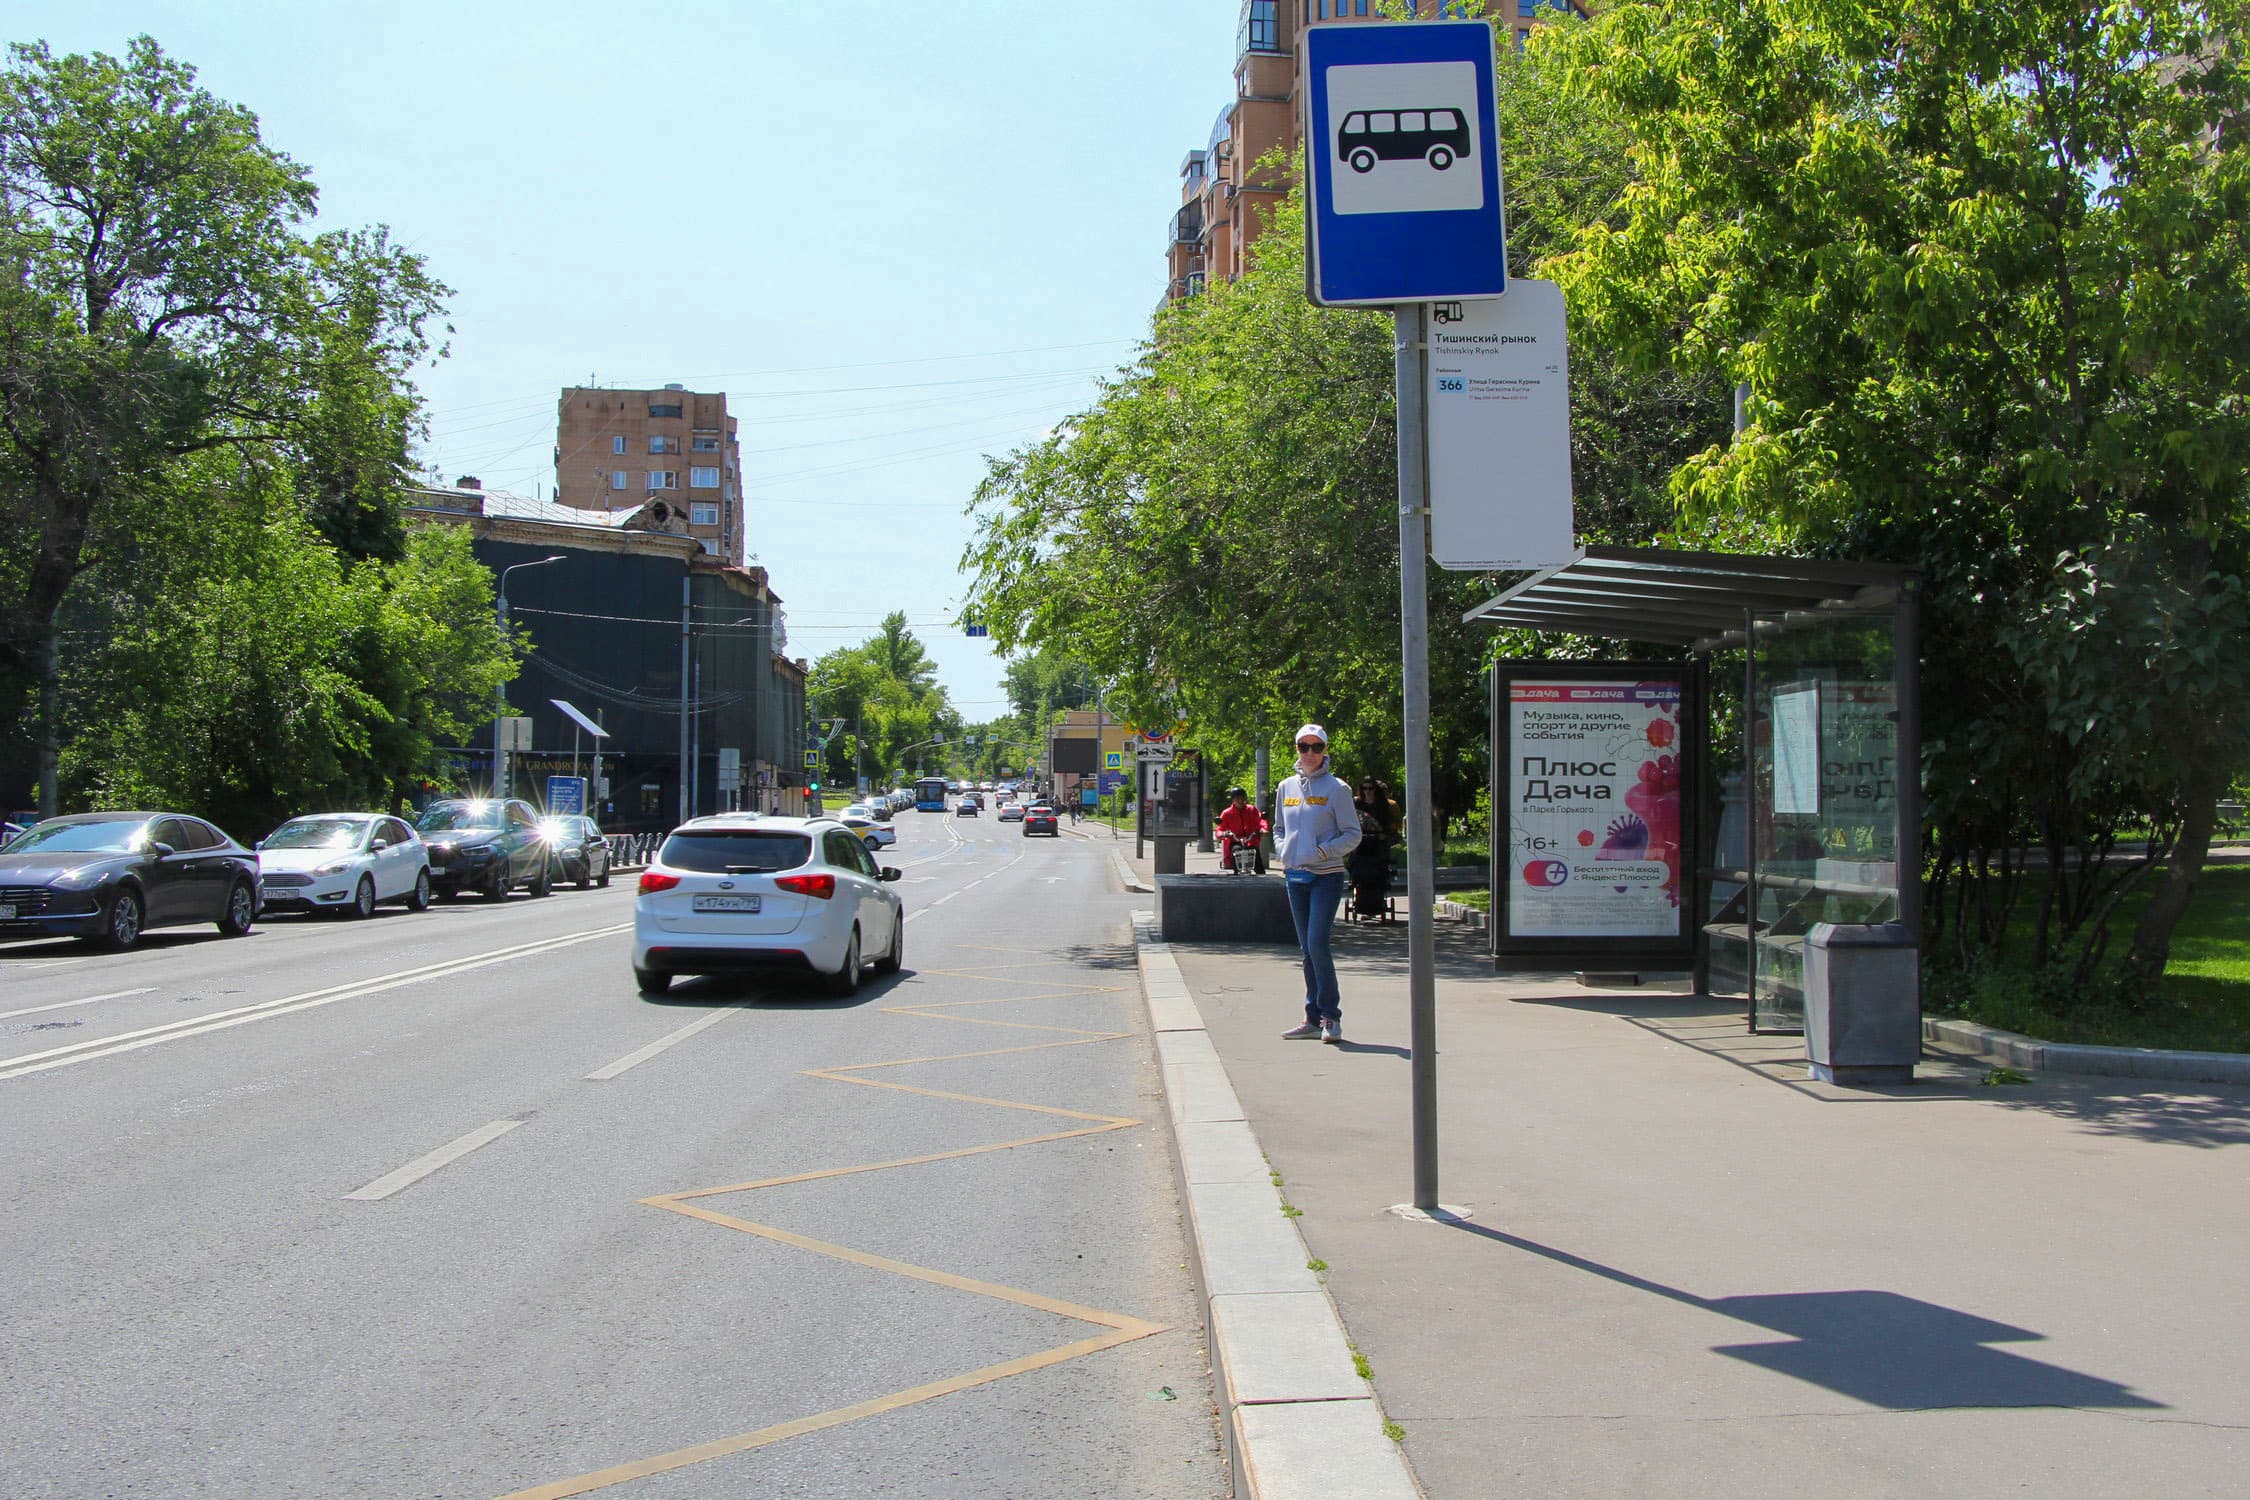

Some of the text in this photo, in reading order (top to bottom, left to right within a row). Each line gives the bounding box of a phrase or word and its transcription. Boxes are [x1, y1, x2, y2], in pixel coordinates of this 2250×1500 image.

[1435, 333, 1537, 346] Тишинский рынок
[1436, 347, 1500, 356] Tishinskiy Rynok
[1439, 379, 1463, 391] 366
[1523, 710, 1624, 722] Музыка, кино,
[1523, 722, 1631, 731] спорт и другие
[1523, 731, 1585, 740] события
[1523, 757, 1617, 777] Плюс
[1523, 779, 1612, 803] Дача
[1529, 804, 1556, 814] Парке
[1556, 804, 1594, 814] Горького
[1523, 836, 1559, 850] 16+
[1636, 866, 1660, 874] вход
[1618, 873, 1661, 881] Плюсом
